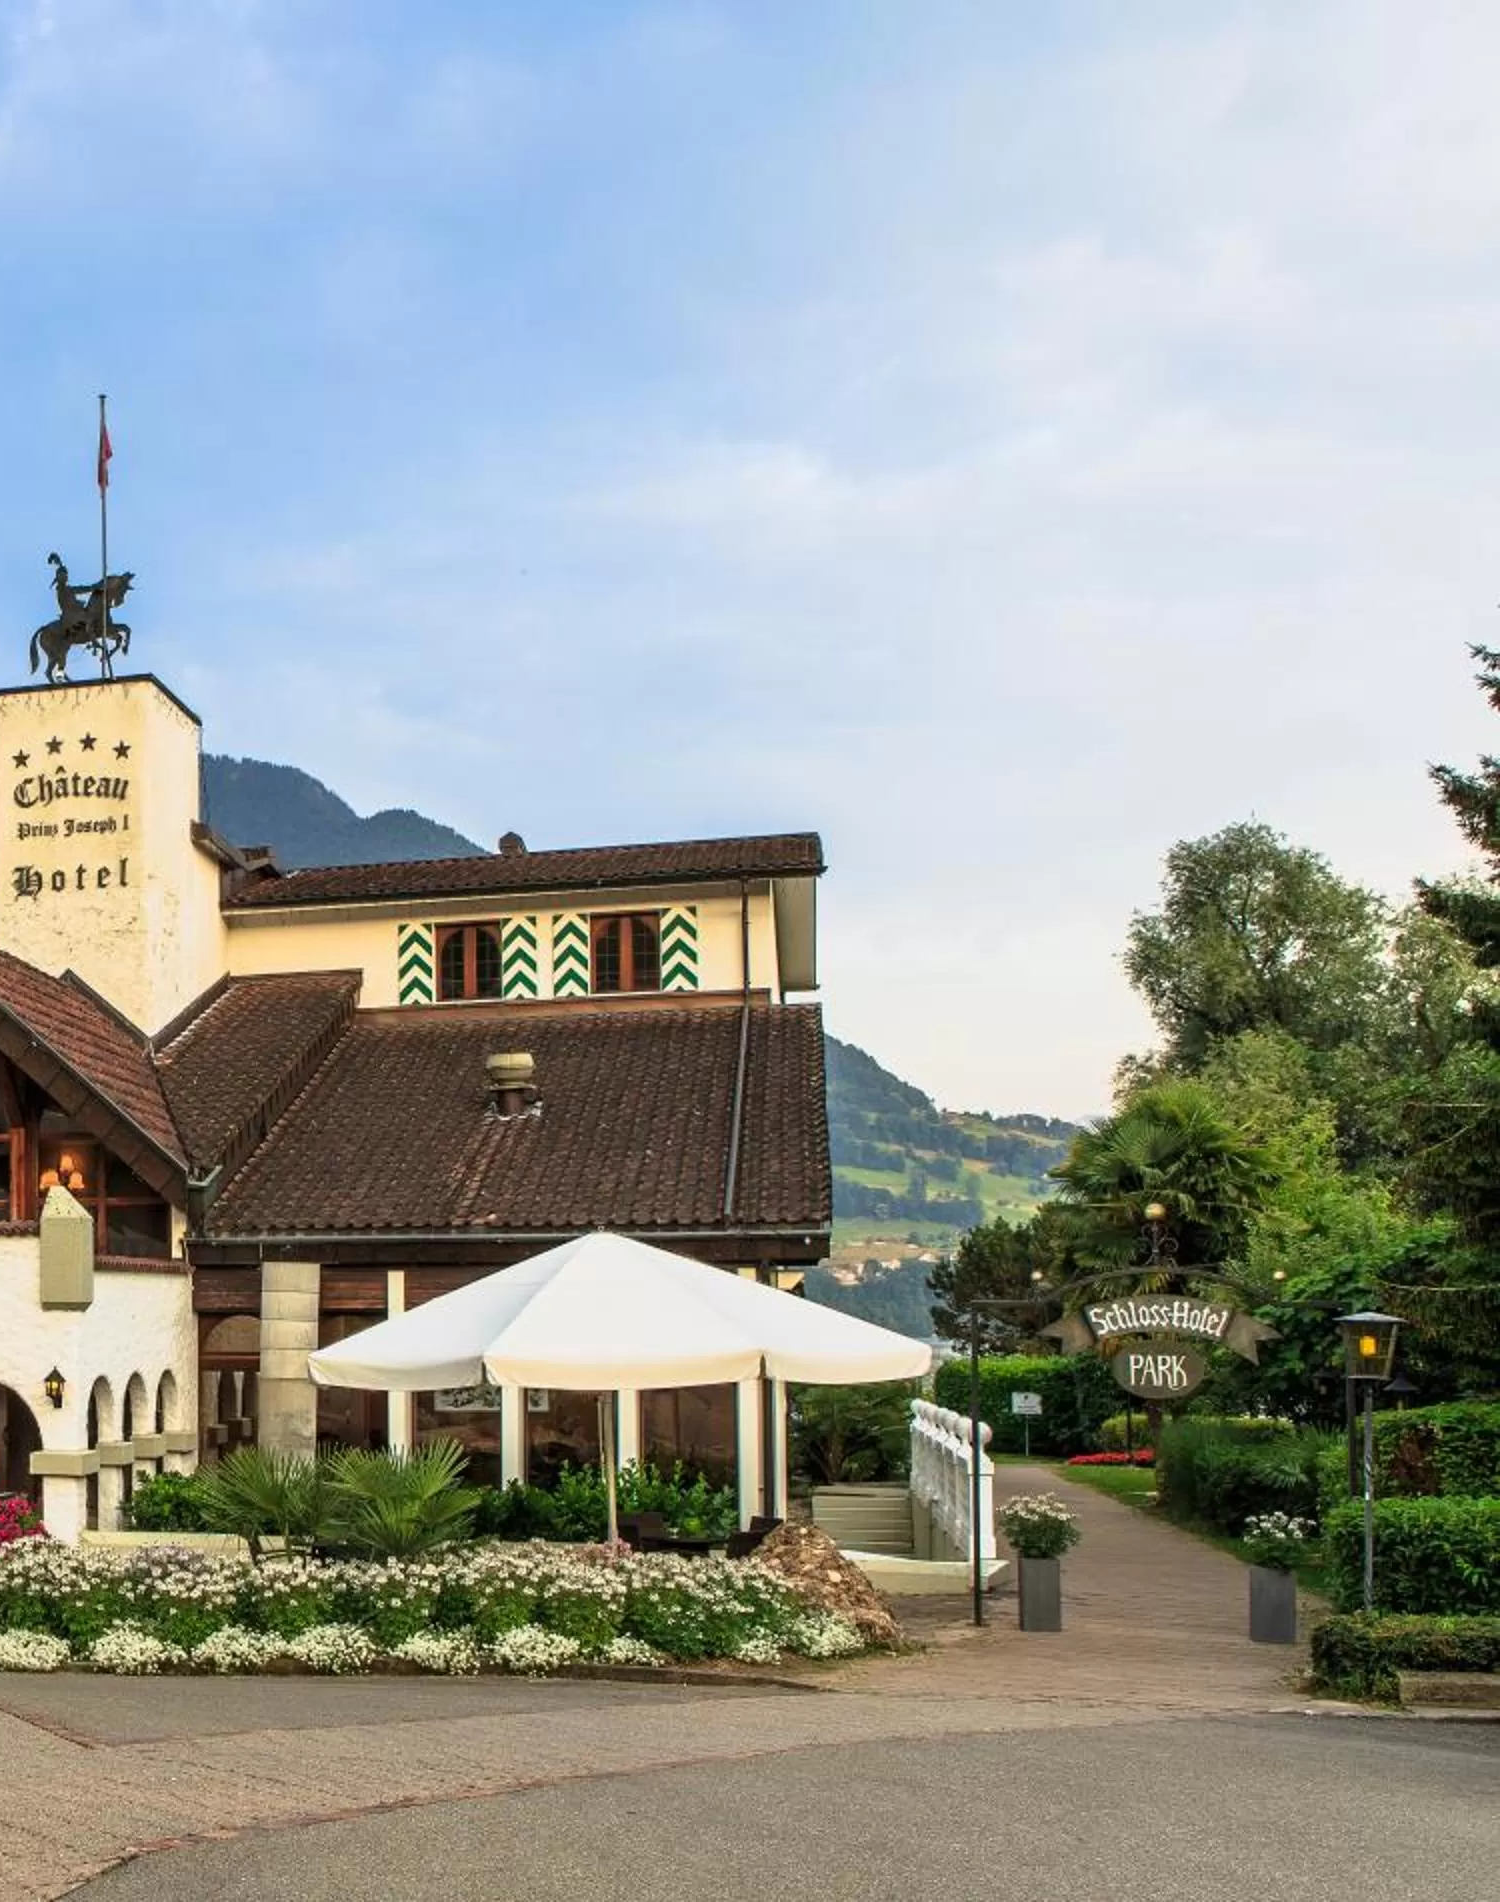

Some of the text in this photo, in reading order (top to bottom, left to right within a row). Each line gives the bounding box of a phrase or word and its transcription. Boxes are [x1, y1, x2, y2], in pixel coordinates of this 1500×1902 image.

[13, 766, 129, 809] Château
[17, 822, 58, 840] Prinz
[64, 815, 117, 837] Joseph
[11, 857, 129, 901] Hotel
[1129, 1354, 1188, 1391] PARK
